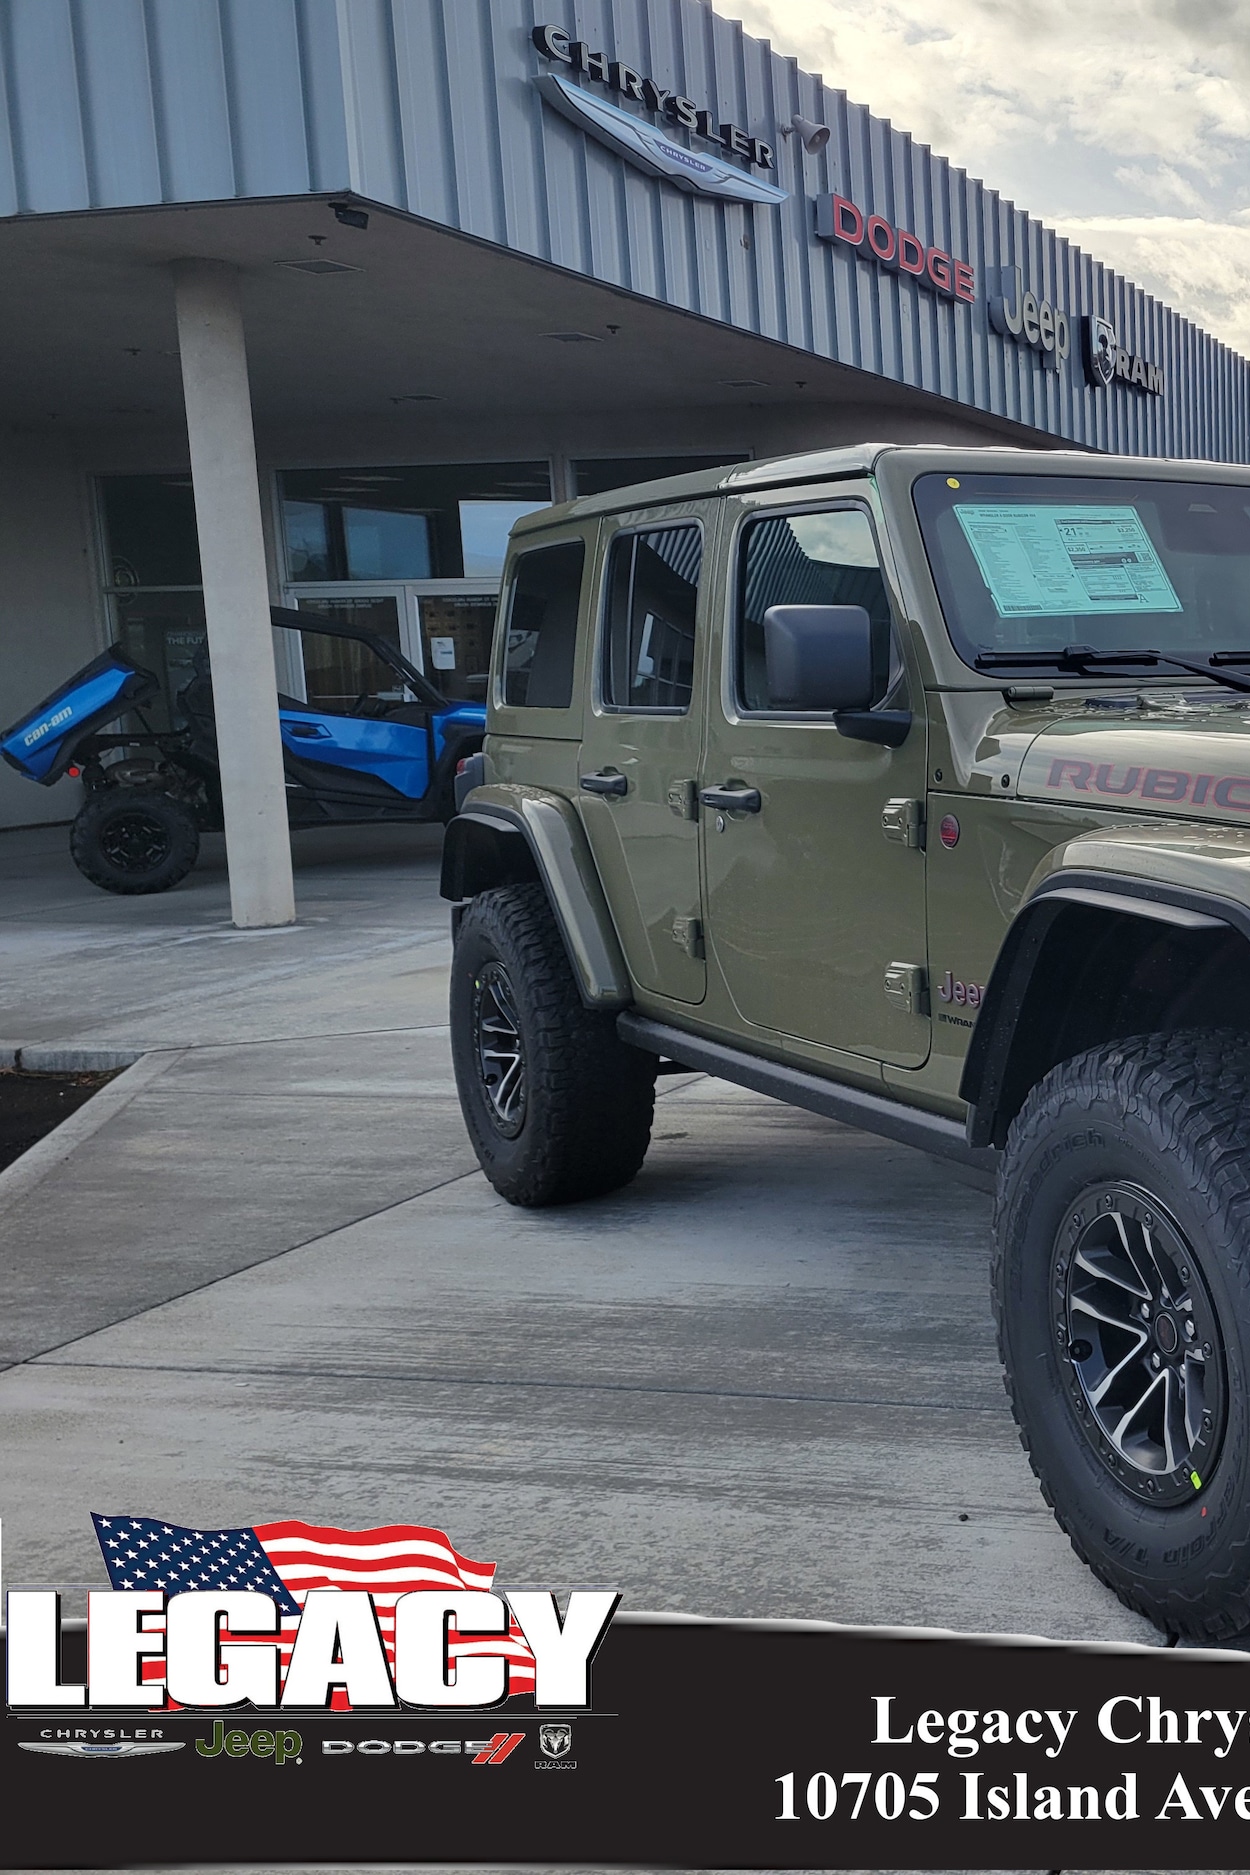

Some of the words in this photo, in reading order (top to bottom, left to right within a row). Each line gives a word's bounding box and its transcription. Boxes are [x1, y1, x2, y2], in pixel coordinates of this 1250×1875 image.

[535, 25, 775, 169] CHRYSLER
[660, 145, 706, 171] CHRYSLER
[832, 193, 976, 305] DODGE
[1003, 266, 1070, 370] Jeep
[1115, 347, 1164, 396] RAM
[1064, 528, 1077, 536] 21
[166, 637, 185, 645] THE
[24, 706, 73, 747] can-am
